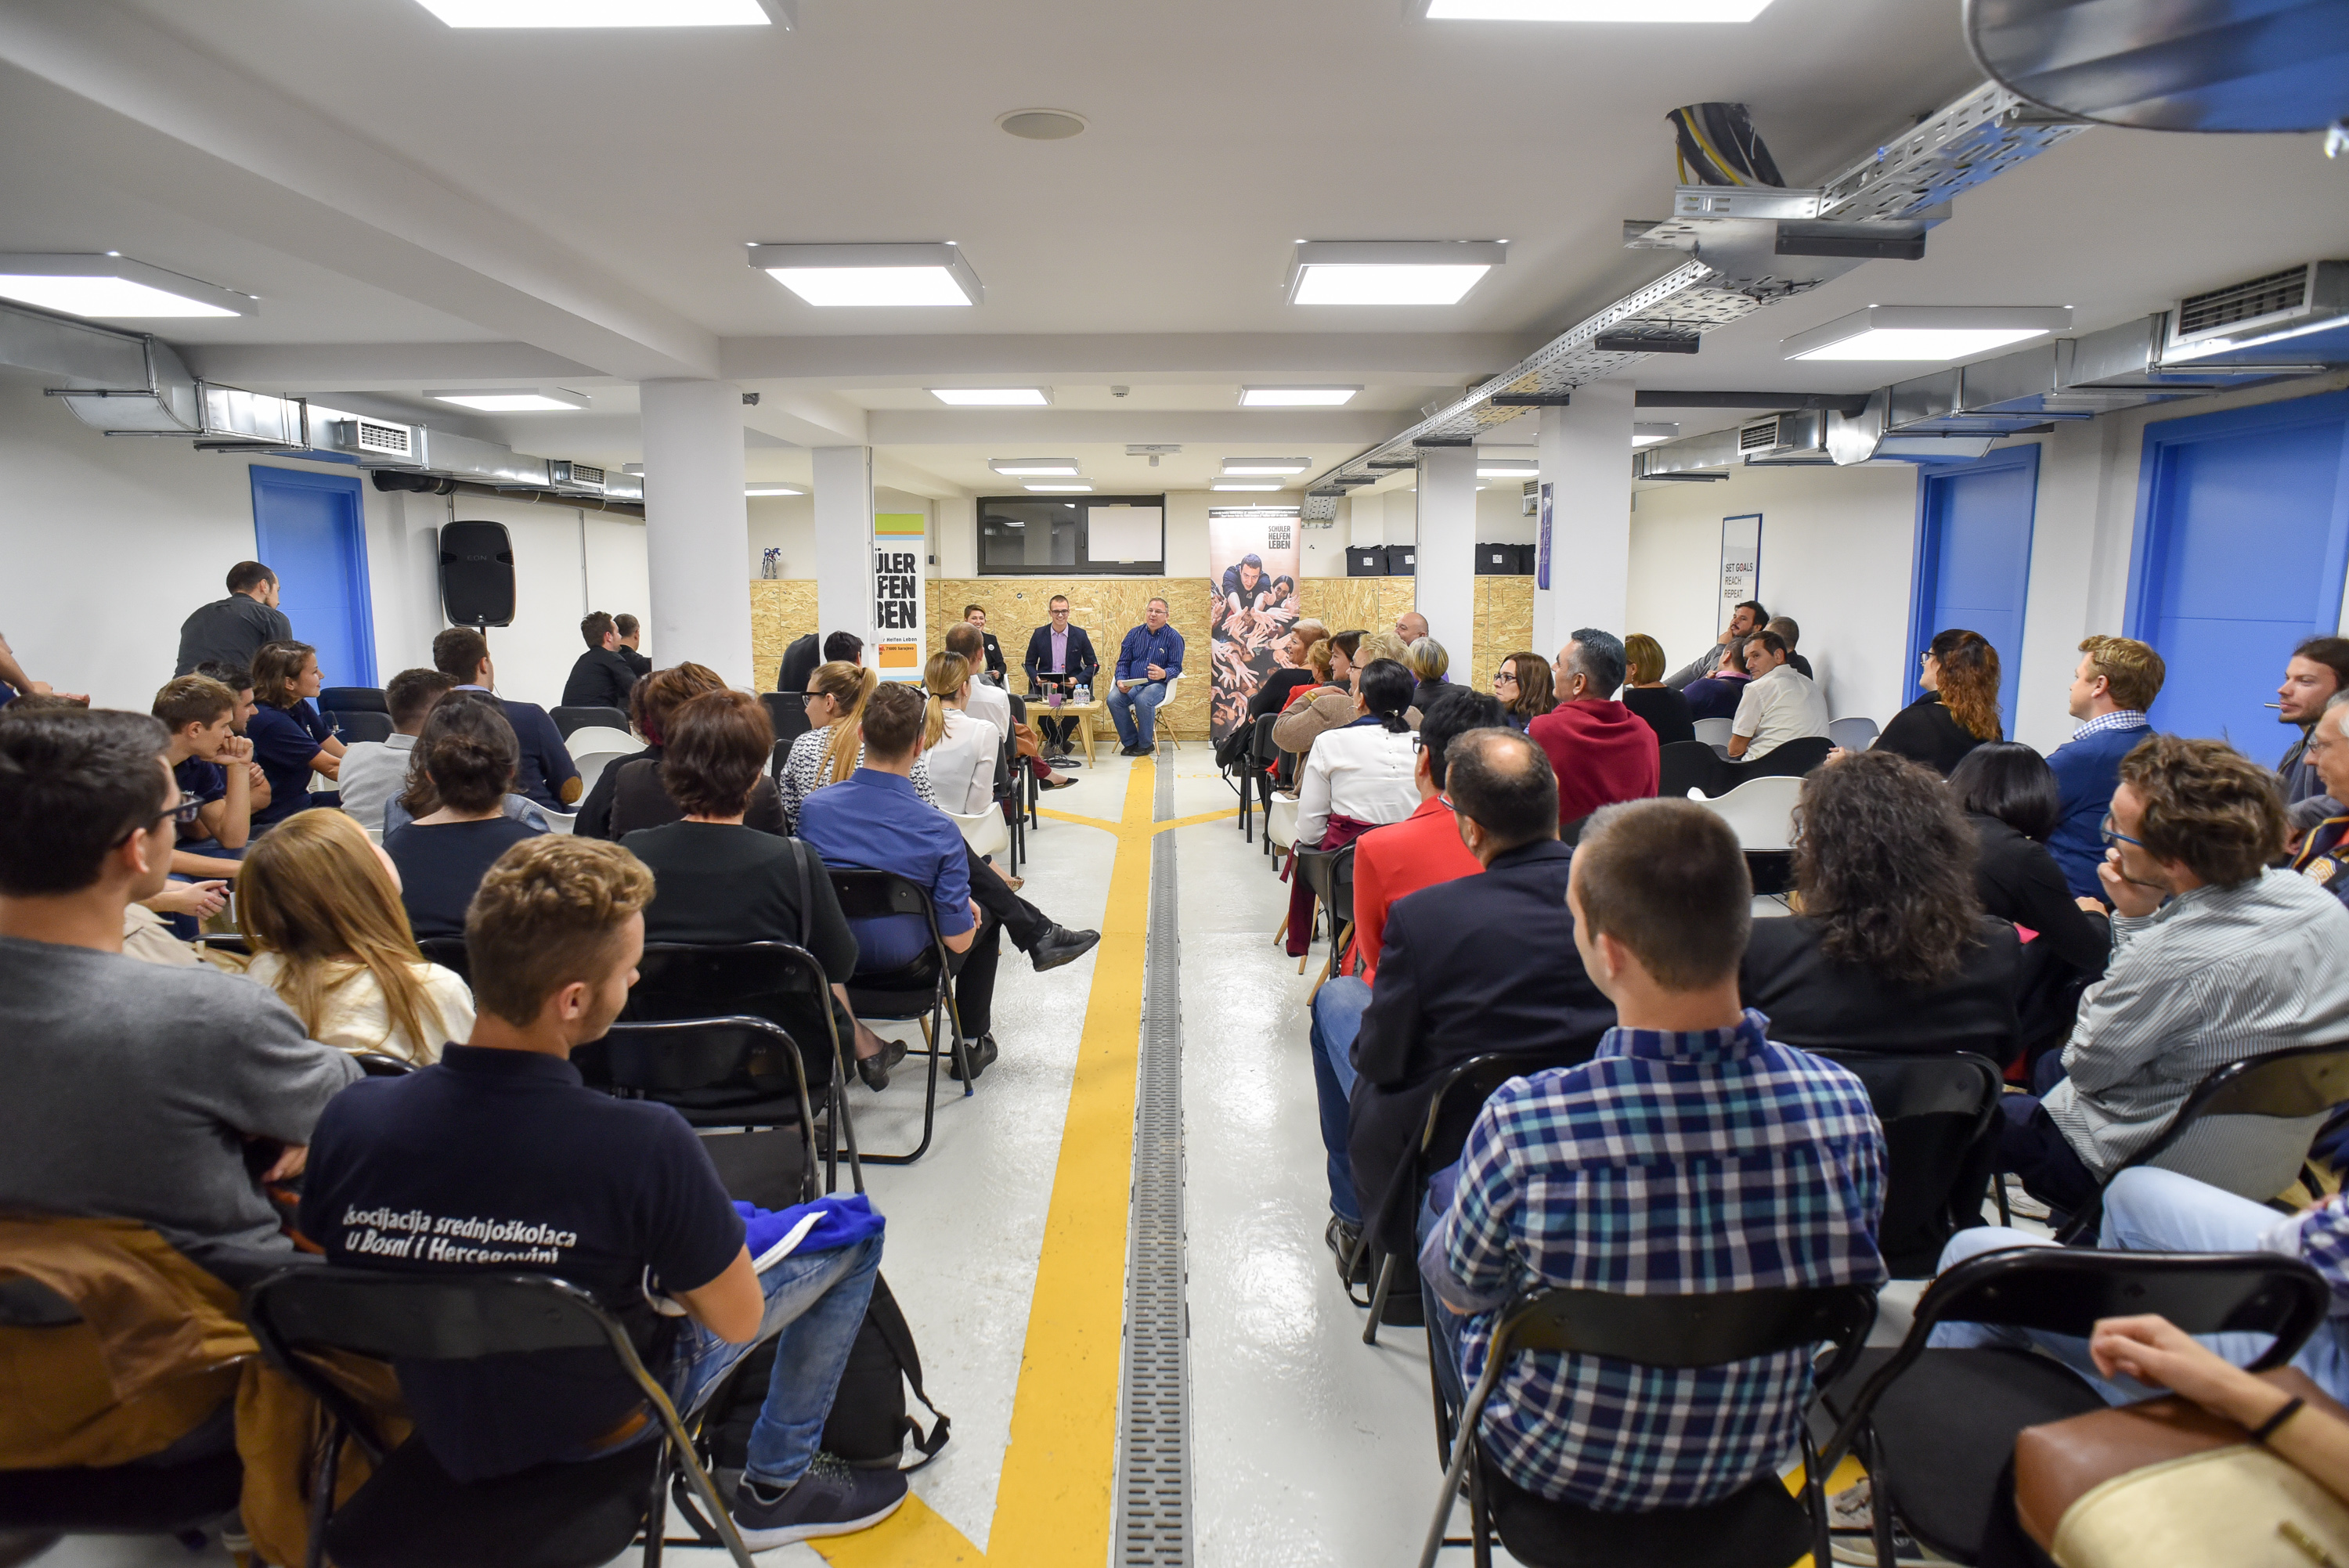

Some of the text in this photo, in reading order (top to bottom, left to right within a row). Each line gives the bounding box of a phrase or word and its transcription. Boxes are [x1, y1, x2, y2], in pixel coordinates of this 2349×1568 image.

[1268, 540, 1290, 549] LEBEN
[1725, 562, 1753, 572] SET GOALS
[1724, 576, 1742, 586] REACH
[877, 575, 916, 599] FEN
[1723, 589, 1743, 598] REPEAT
[358, 1227, 416, 1258] Bosni
[413, 1235, 427, 1259] i
